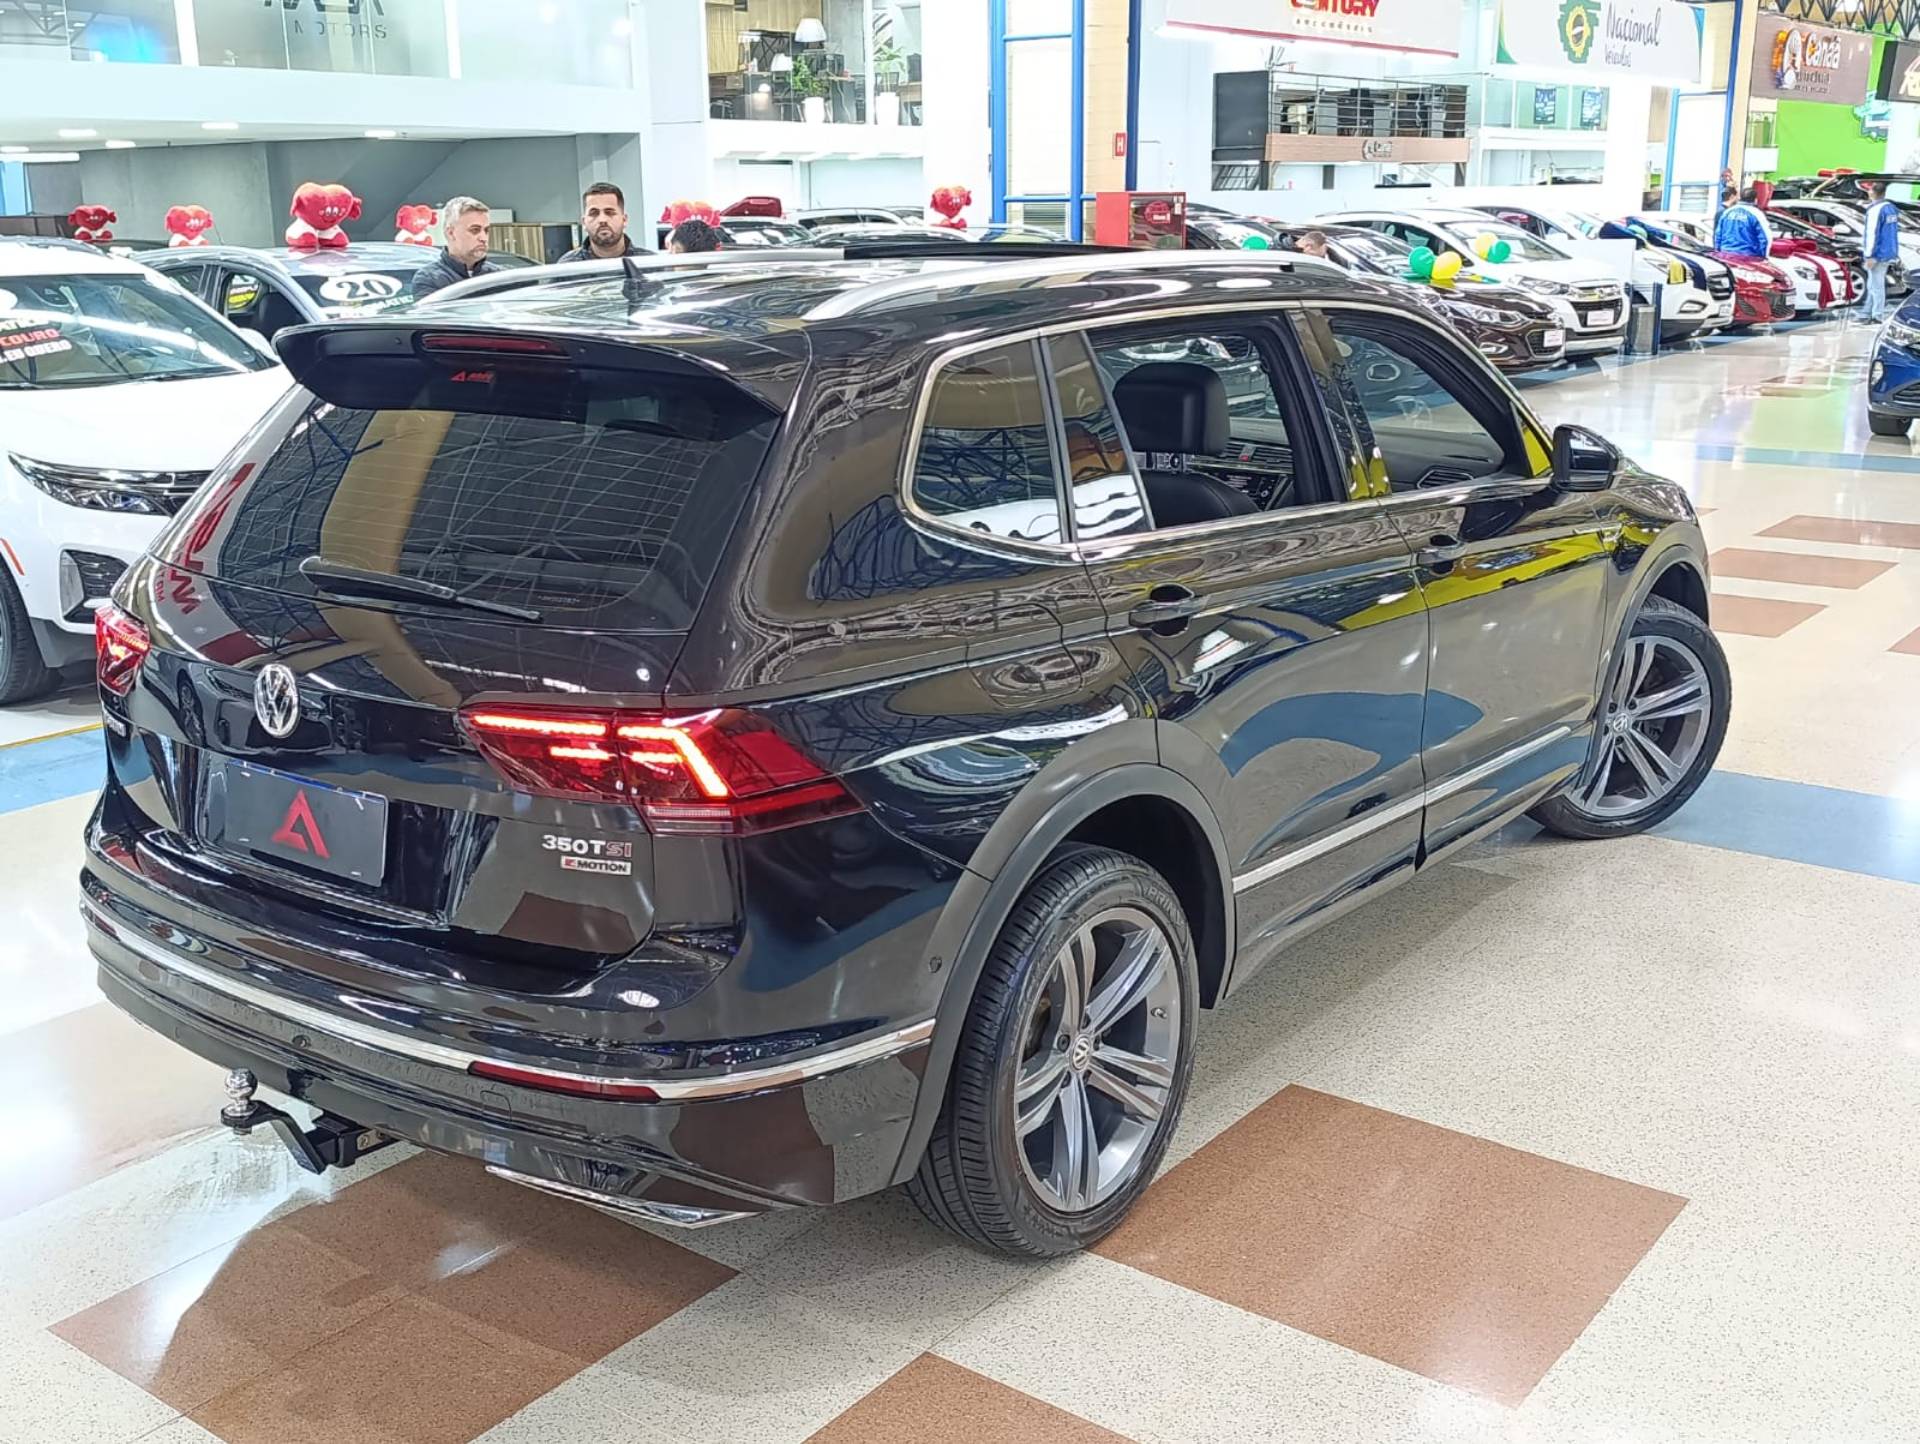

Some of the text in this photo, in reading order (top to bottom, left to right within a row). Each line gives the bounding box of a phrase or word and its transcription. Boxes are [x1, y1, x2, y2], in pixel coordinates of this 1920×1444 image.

[1606, 4, 1661, 46] Nacional
[336, 278, 393, 300] 20
[541, 834, 632, 858] 350TSI
